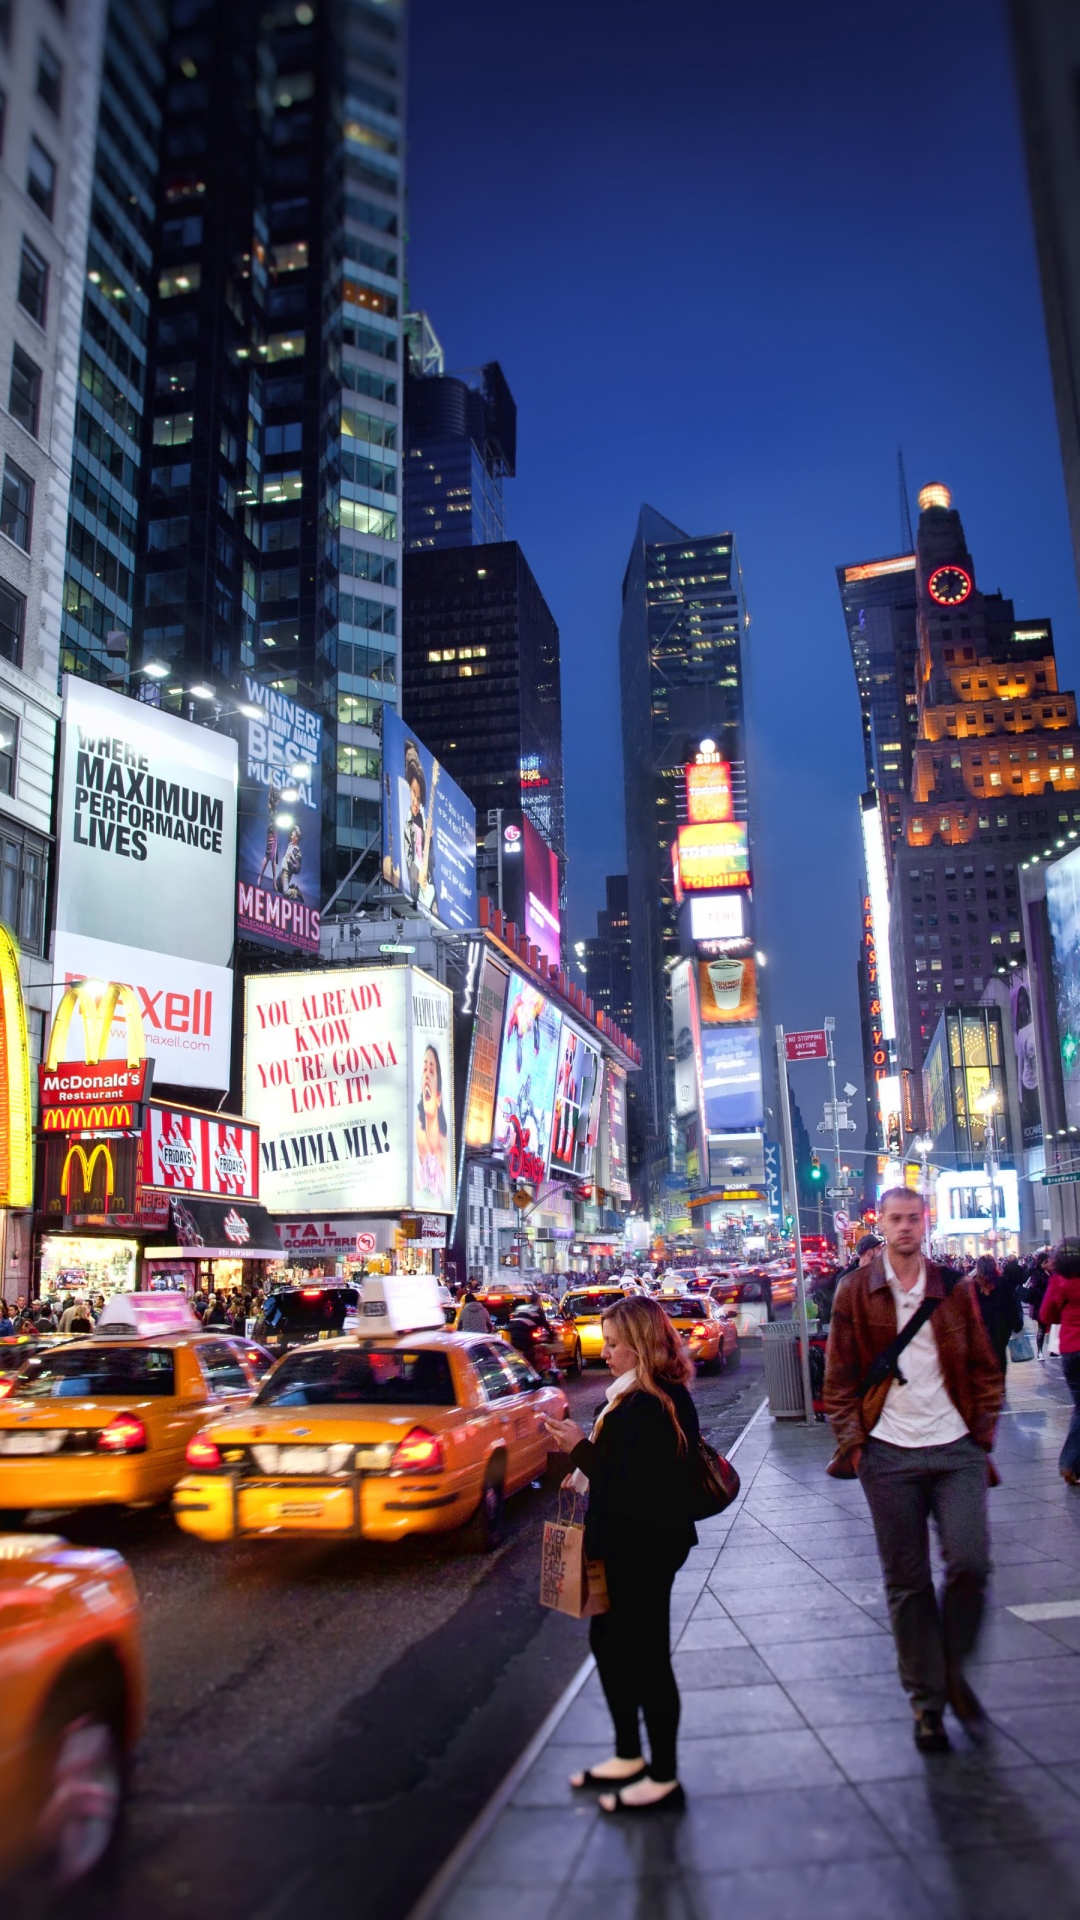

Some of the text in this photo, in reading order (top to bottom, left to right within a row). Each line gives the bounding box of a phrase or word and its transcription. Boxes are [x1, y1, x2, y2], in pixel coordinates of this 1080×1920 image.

[246, 677, 321, 738] WINNER!
[77, 725, 149, 772] WHERE
[248, 720, 317, 785] BEST
[271, 714, 292, 738] TONY
[293, 727, 318, 753] AWARD
[76, 751, 224, 831] MAXIMUM
[247, 758, 317, 809] MUSICAL
[73, 812, 148, 861] LIVES
[75, 788, 222, 854] PERFORMANCE
[504, 841, 521, 853] LG
[682, 873, 750, 889] TOSHIBA
[238, 881, 320, 941] MEMPHIS
[705, 911, 737, 922] TDK
[864, 897, 877, 982] ERNST
[255, 981, 384, 1030] YOU ALREADY
[110, 1027, 211, 1052] wwmaxell.com
[294, 1018, 351, 1053] KNOW
[794, 1041, 818, 1050] ANYTIME
[797, 1033, 823, 1042] STOPPING
[43, 1071, 141, 1092] McDonald's
[257, 1040, 398, 1089] YOU'RE GONNA
[58, 1090, 124, 1101] Restaurant
[290, 1074, 373, 1114] LOVE IT!
[260, 1120, 391, 1174] MAMMA MIA!
[1047, 1175, 1078, 1184] Broadway
[283, 1236, 357, 1249] COMPUTERS
